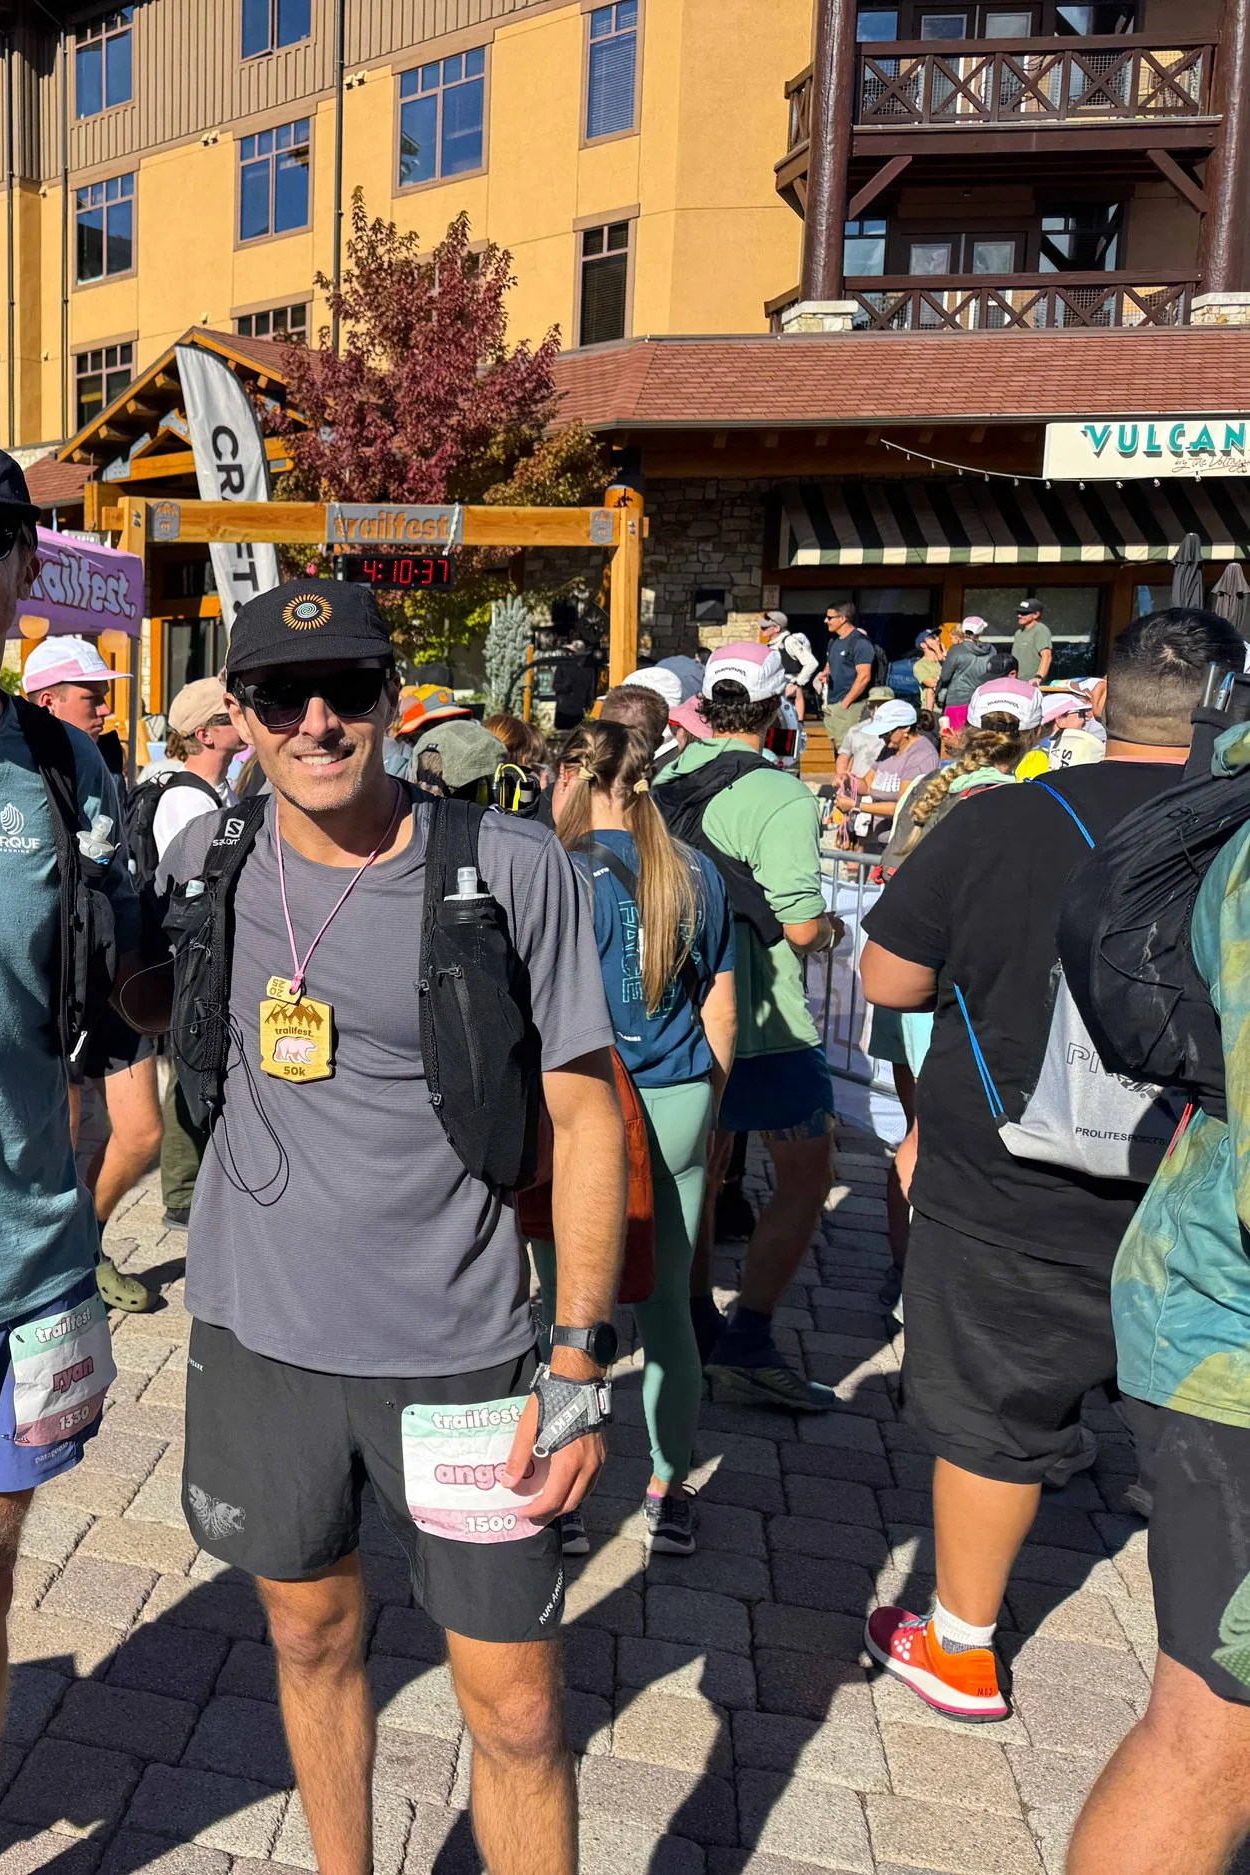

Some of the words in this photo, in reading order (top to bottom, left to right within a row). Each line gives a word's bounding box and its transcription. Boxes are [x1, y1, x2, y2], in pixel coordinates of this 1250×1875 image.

[334, 511, 449, 540] trailfest
[283, 1065, 306, 1076] 50k
[52, 1356, 95, 1394] ryan
[59, 1405, 91, 1432] 1330
[551, 1402, 580, 1435] LEKI
[465, 1514, 518, 1534] 1500
[539, 1602, 554, 1625] RUN
